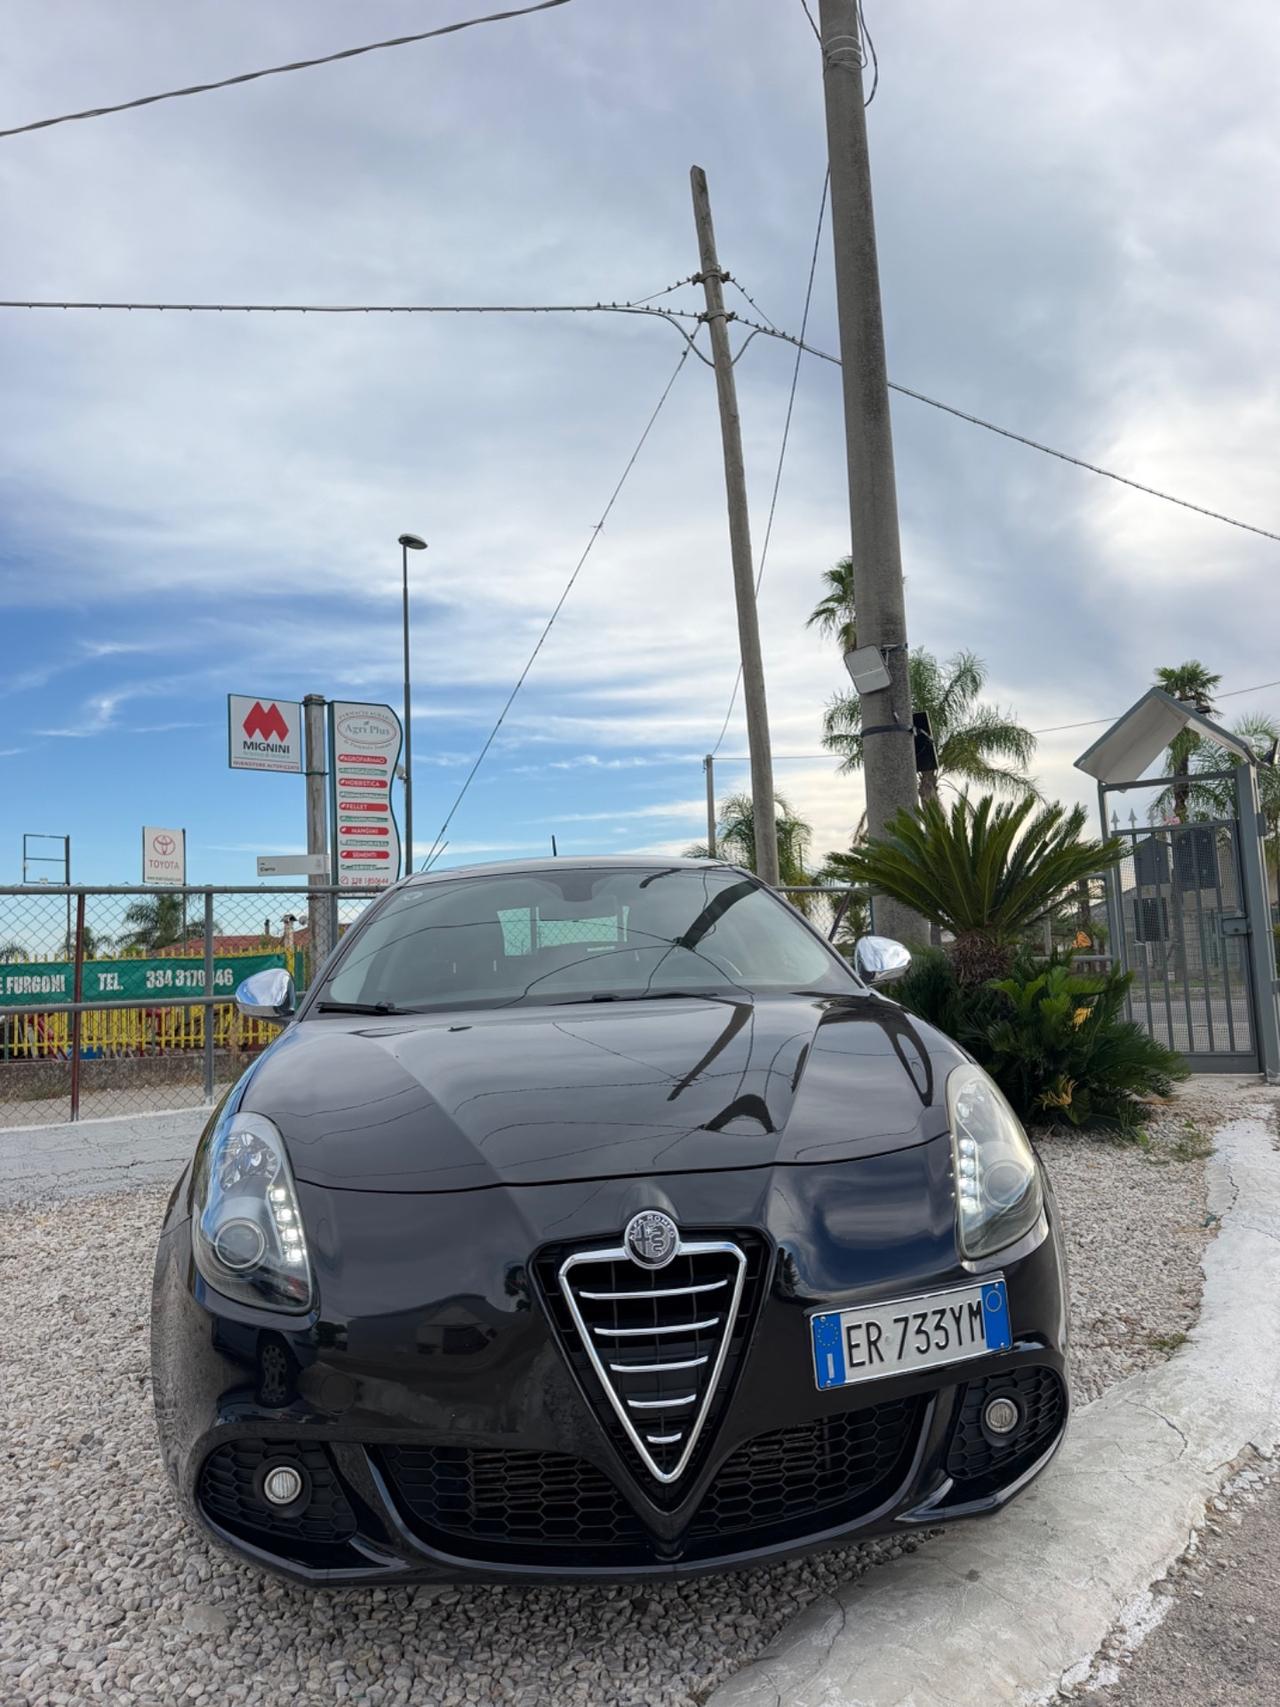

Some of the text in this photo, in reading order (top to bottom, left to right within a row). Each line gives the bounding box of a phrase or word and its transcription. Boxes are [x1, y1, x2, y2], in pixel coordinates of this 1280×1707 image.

[243, 740, 290, 754] MIGNINI
[149, 860, 179, 869] TOYOTA
[6, 974, 65, 994] FURGONI
[97, 973, 124, 991] TEL.
[146, 969, 173, 988] 334
[175, 968, 233, 987] 317046
